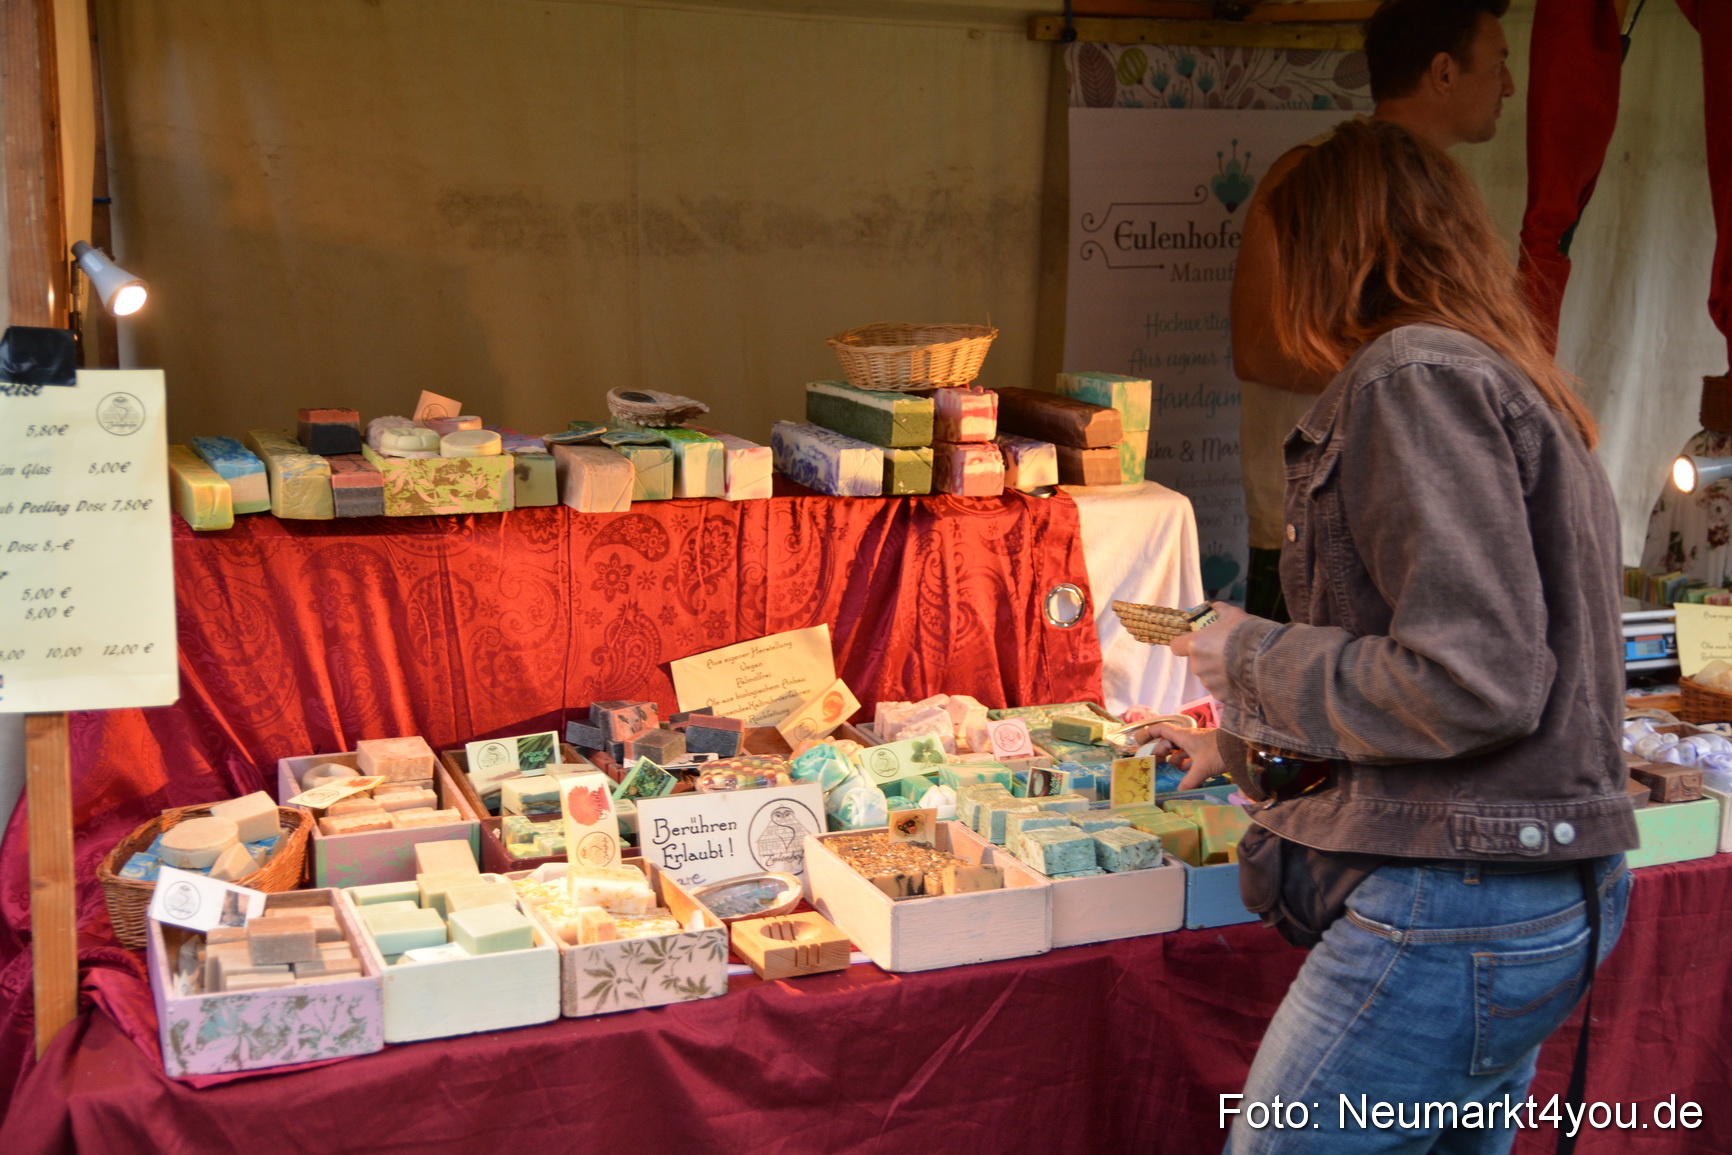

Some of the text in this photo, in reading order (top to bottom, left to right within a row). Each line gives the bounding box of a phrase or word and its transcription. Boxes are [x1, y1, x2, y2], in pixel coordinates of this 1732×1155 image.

[1128, 348, 1161, 374] Aus
[1180, 440, 1195, 462] &
[21, 463, 52, 478] Glas
[88, 461, 131, 476] 8,00€
[19, 500, 70, 516] Peeling
[76, 499, 107, 512] Dose
[112, 498, 153, 513] 7,80€
[7, 540, 38, 553] Dose
[21, 586, 72, 602] 5,00 €
[25, 605, 75, 621] 8,00 €
[45, 646, 82, 660] 10,00
[103, 643, 139, 657] 12,00
[143, 642, 154, 654] €
[740, 661, 763, 672] Vegan
[652, 815, 737, 845] Berühren
[661, 840, 724, 870] Erlaubt
